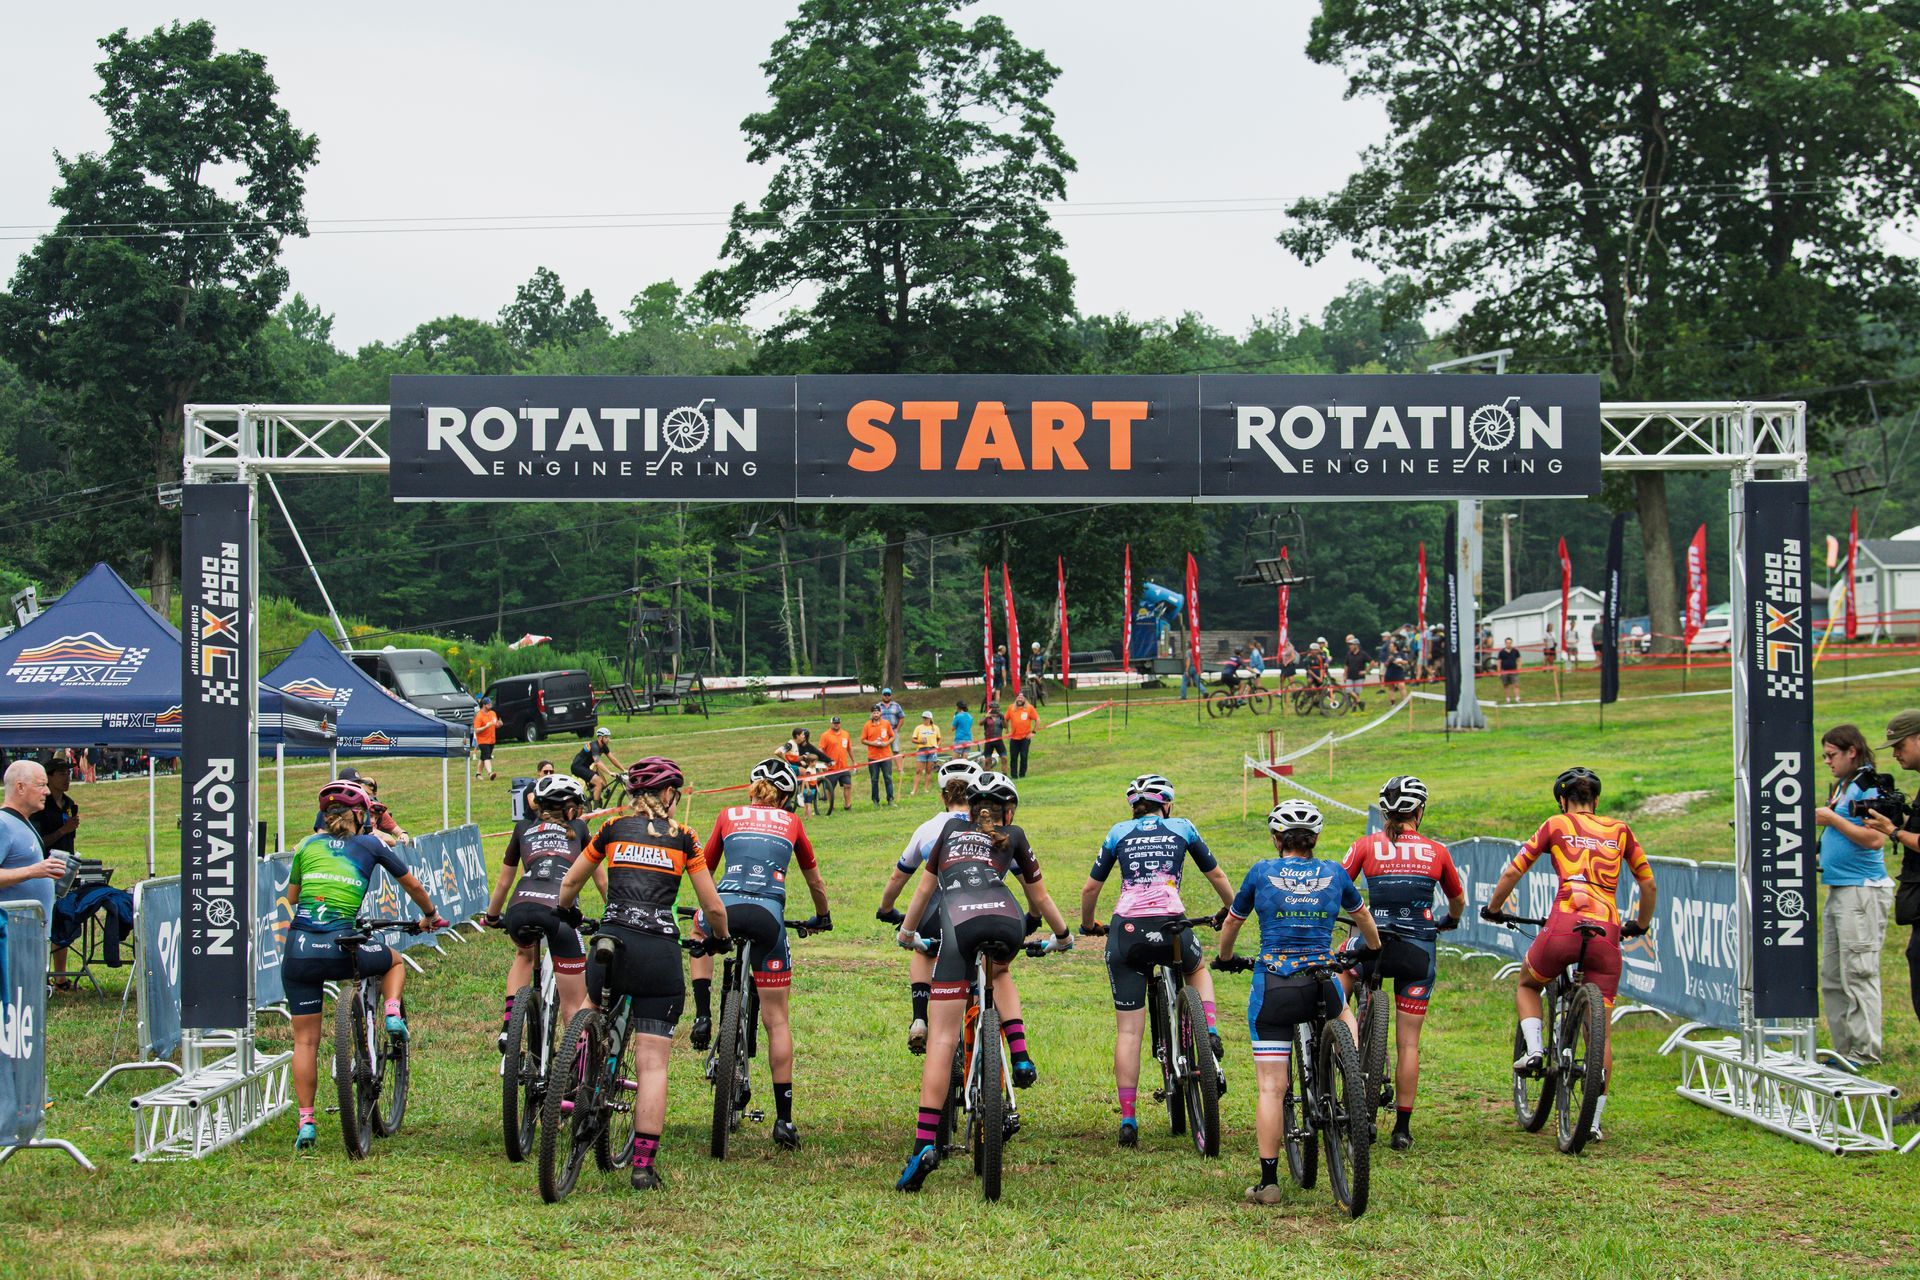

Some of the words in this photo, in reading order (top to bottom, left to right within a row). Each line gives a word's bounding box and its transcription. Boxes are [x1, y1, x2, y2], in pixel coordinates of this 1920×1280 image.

[427, 405, 757, 475] ROTATION
[846, 400, 1148, 471] START
[1237, 403, 1563, 473] ROTATION
[493, 461, 757, 476] ENGINEERING
[1302, 459, 1563, 474] ENGINEERING
[221, 542, 239, 608] RACE
[1765, 552, 1782, 601] DAY
[1783, 538, 1801, 603] RACE
[202, 556, 219, 606] DAY
[1448, 574, 1458, 653] cannondale
[191, 605, 199, 675] CHAMPIONSHIP
[201, 606, 239, 680] XC
[1755, 600, 1764, 670] CHAMPIONSHIP
[1765, 602, 1803, 674] XC
[6, 666, 71, 676] RACE
[16, 674, 65, 683] DAY
[63, 666, 139, 683] XC
[109, 720, 128, 728] DAY
[128, 713, 156, 728] XC
[728, 806, 789, 826] UTC
[537, 833, 568, 841] MOTORE
[958, 835, 993, 847] MOTORE
[1124, 835, 1177, 846] TREK
[1575, 836, 1621, 851] REVEL
[193, 758, 236, 955] ROTATION
[614, 844, 672, 864] LAUREL
[962, 843, 991, 854] KATE'S
[1373, 841, 1433, 863] UTC
[1761, 751, 1806, 946] ROTATION
[192, 797, 202, 955] ENGINEERING
[728, 864, 743, 873] UTC
[1280, 867, 1313, 880] Stage
[1315, 866, 1321, 876] 1
[1380, 863, 1431, 871] BUTCHERBOX
[1761, 790, 1773, 946] ENGINEERING
[518, 890, 559, 900] TREK
[1285, 895, 1319, 905] Cycling
[958, 901, 1006, 911] TREK
[1276, 911, 1328, 919] AIRLINE
[1374, 909, 1389, 917] UTC
[1671, 896, 1738, 980] ROTATIO
